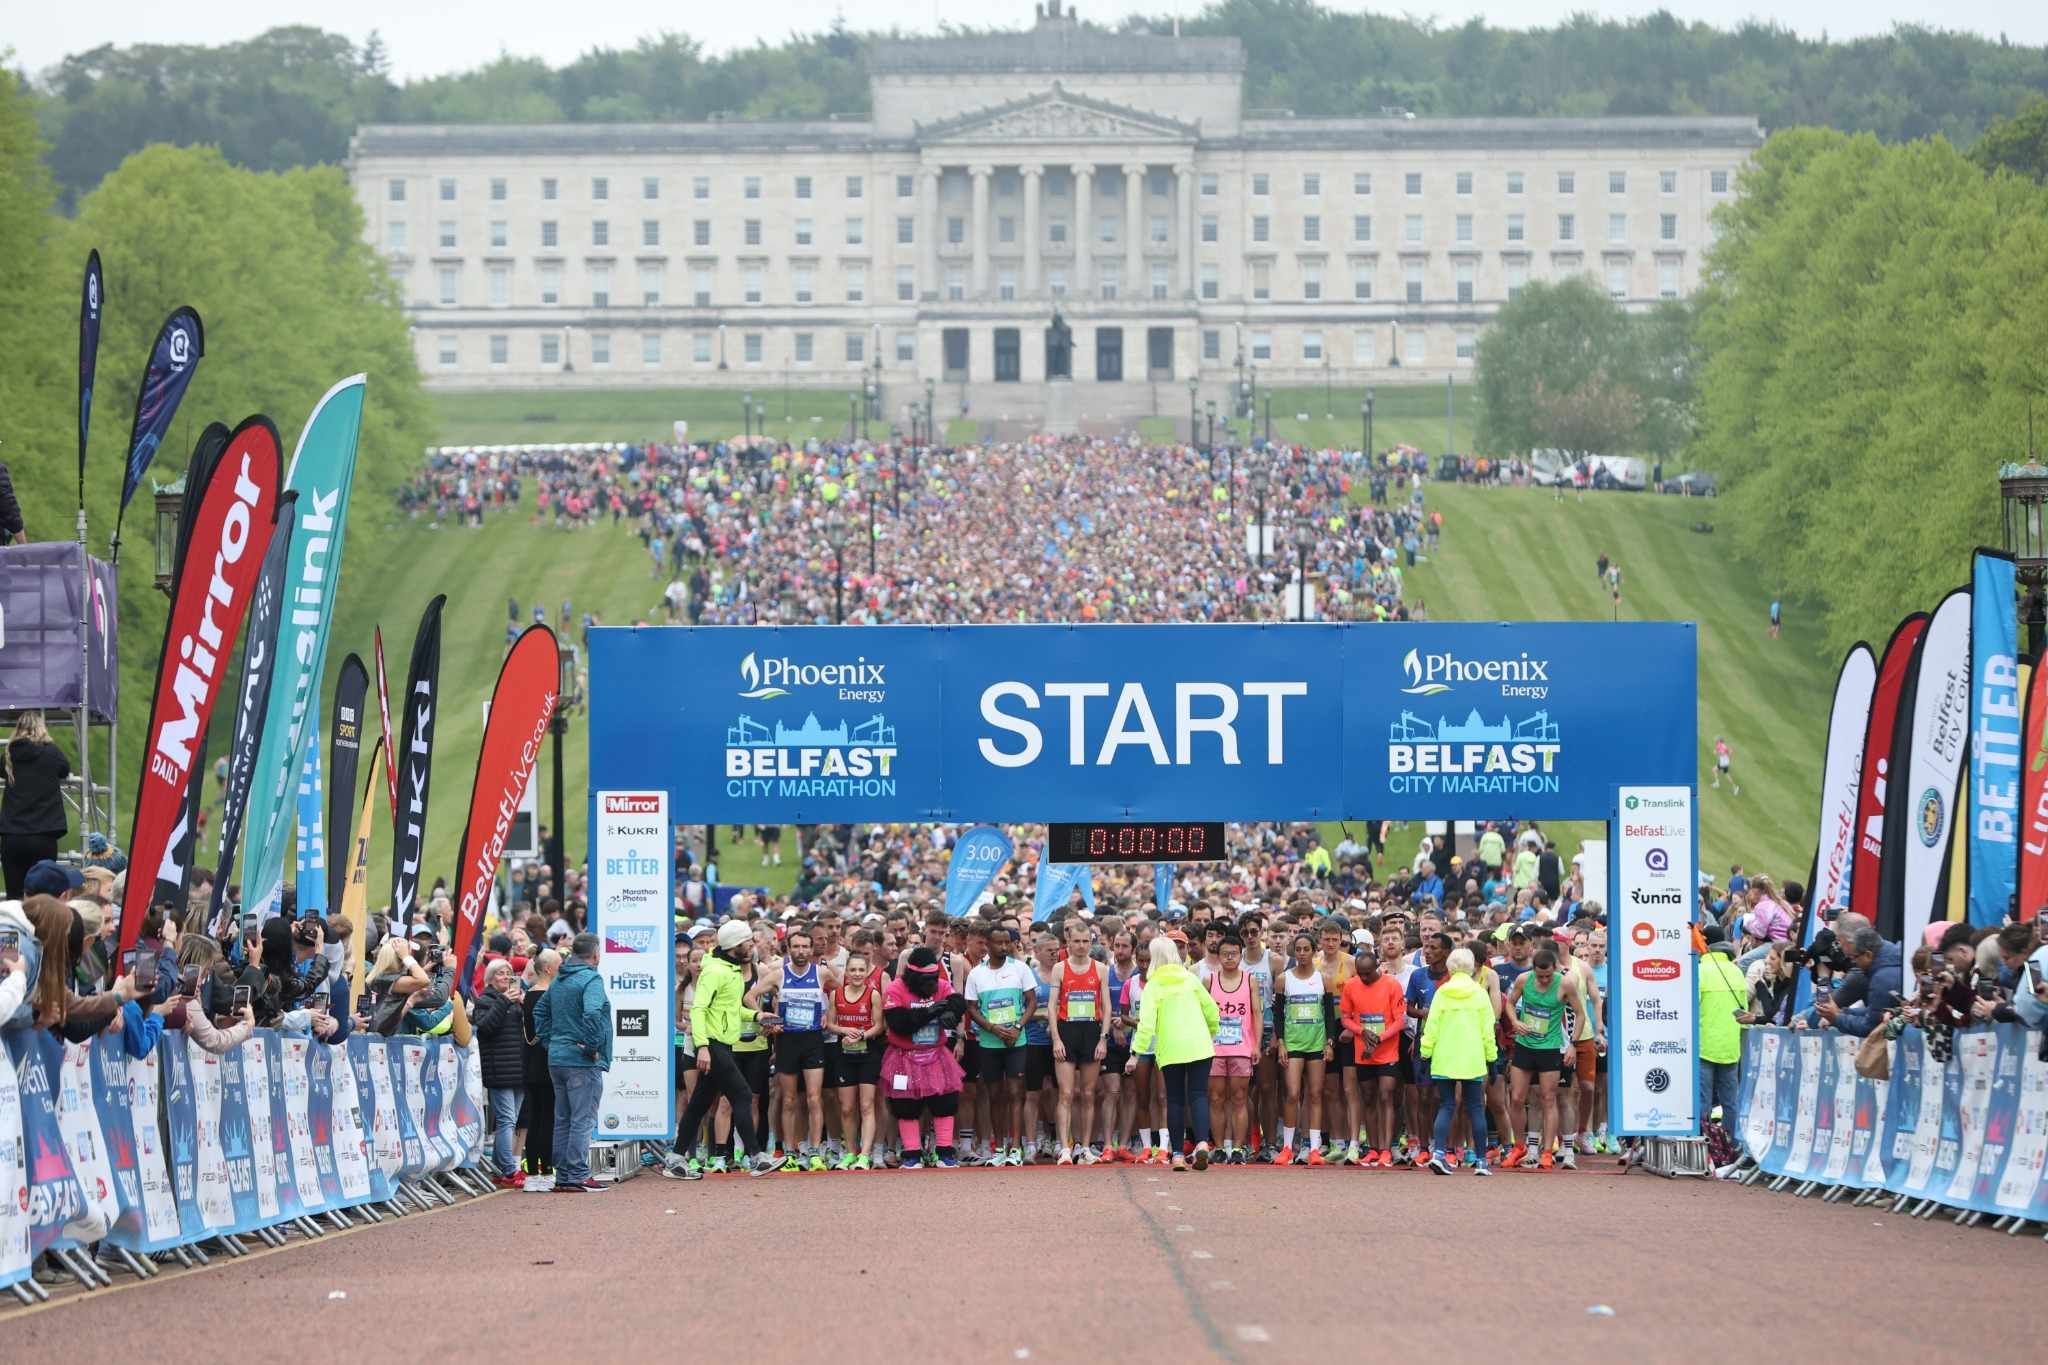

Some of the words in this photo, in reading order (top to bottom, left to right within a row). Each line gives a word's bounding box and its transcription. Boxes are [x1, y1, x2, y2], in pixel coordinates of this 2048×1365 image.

[156, 451, 261, 772] Mirror
[262, 487, 340, 850] slink
[763, 656, 885, 685] Phoenix
[1426, 652, 1549, 681] Phoenix
[839, 688, 885, 703] Energy
[1502, 684, 1549, 699] Energy
[1932, 669, 1958, 757] Belfast
[978, 681, 1308, 768] START
[1943, 720, 1962, 764] City
[1973, 653, 2021, 844] BETTER
[726, 747, 897, 777] BELFAST
[1388, 743, 1560, 773] BELFAST
[726, 779, 773, 797] CITY
[779, 779, 896, 797] MARATHON
[1389, 775, 1436, 793] CITY
[1442, 775, 1559, 793] MARATHON
[390, 680, 430, 938] KUKRI
[460, 690, 557, 926] BelfastLive.co.uk
[609, 798, 658, 812] Mirror
[1642, 799, 1685, 808] Translink
[617, 826, 658, 835] KUKRI
[1625, 825, 1686, 837] BelfastLive
[1090, 827, 1205, 855] 0:00:00
[965, 844, 1001, 862] 3.00
[606, 850, 659, 876] BETTER
[622, 888, 658, 896] Marathon
[1632, 888, 1682, 904] Runna
[1637, 965, 1676, 974] Linwoods
[610, 974, 656, 990] Hurst
[1636, 999, 1661, 1009] visit
[621, 1016, 642, 1025] MAC
[1636, 1009, 1679, 1020] Belfast
